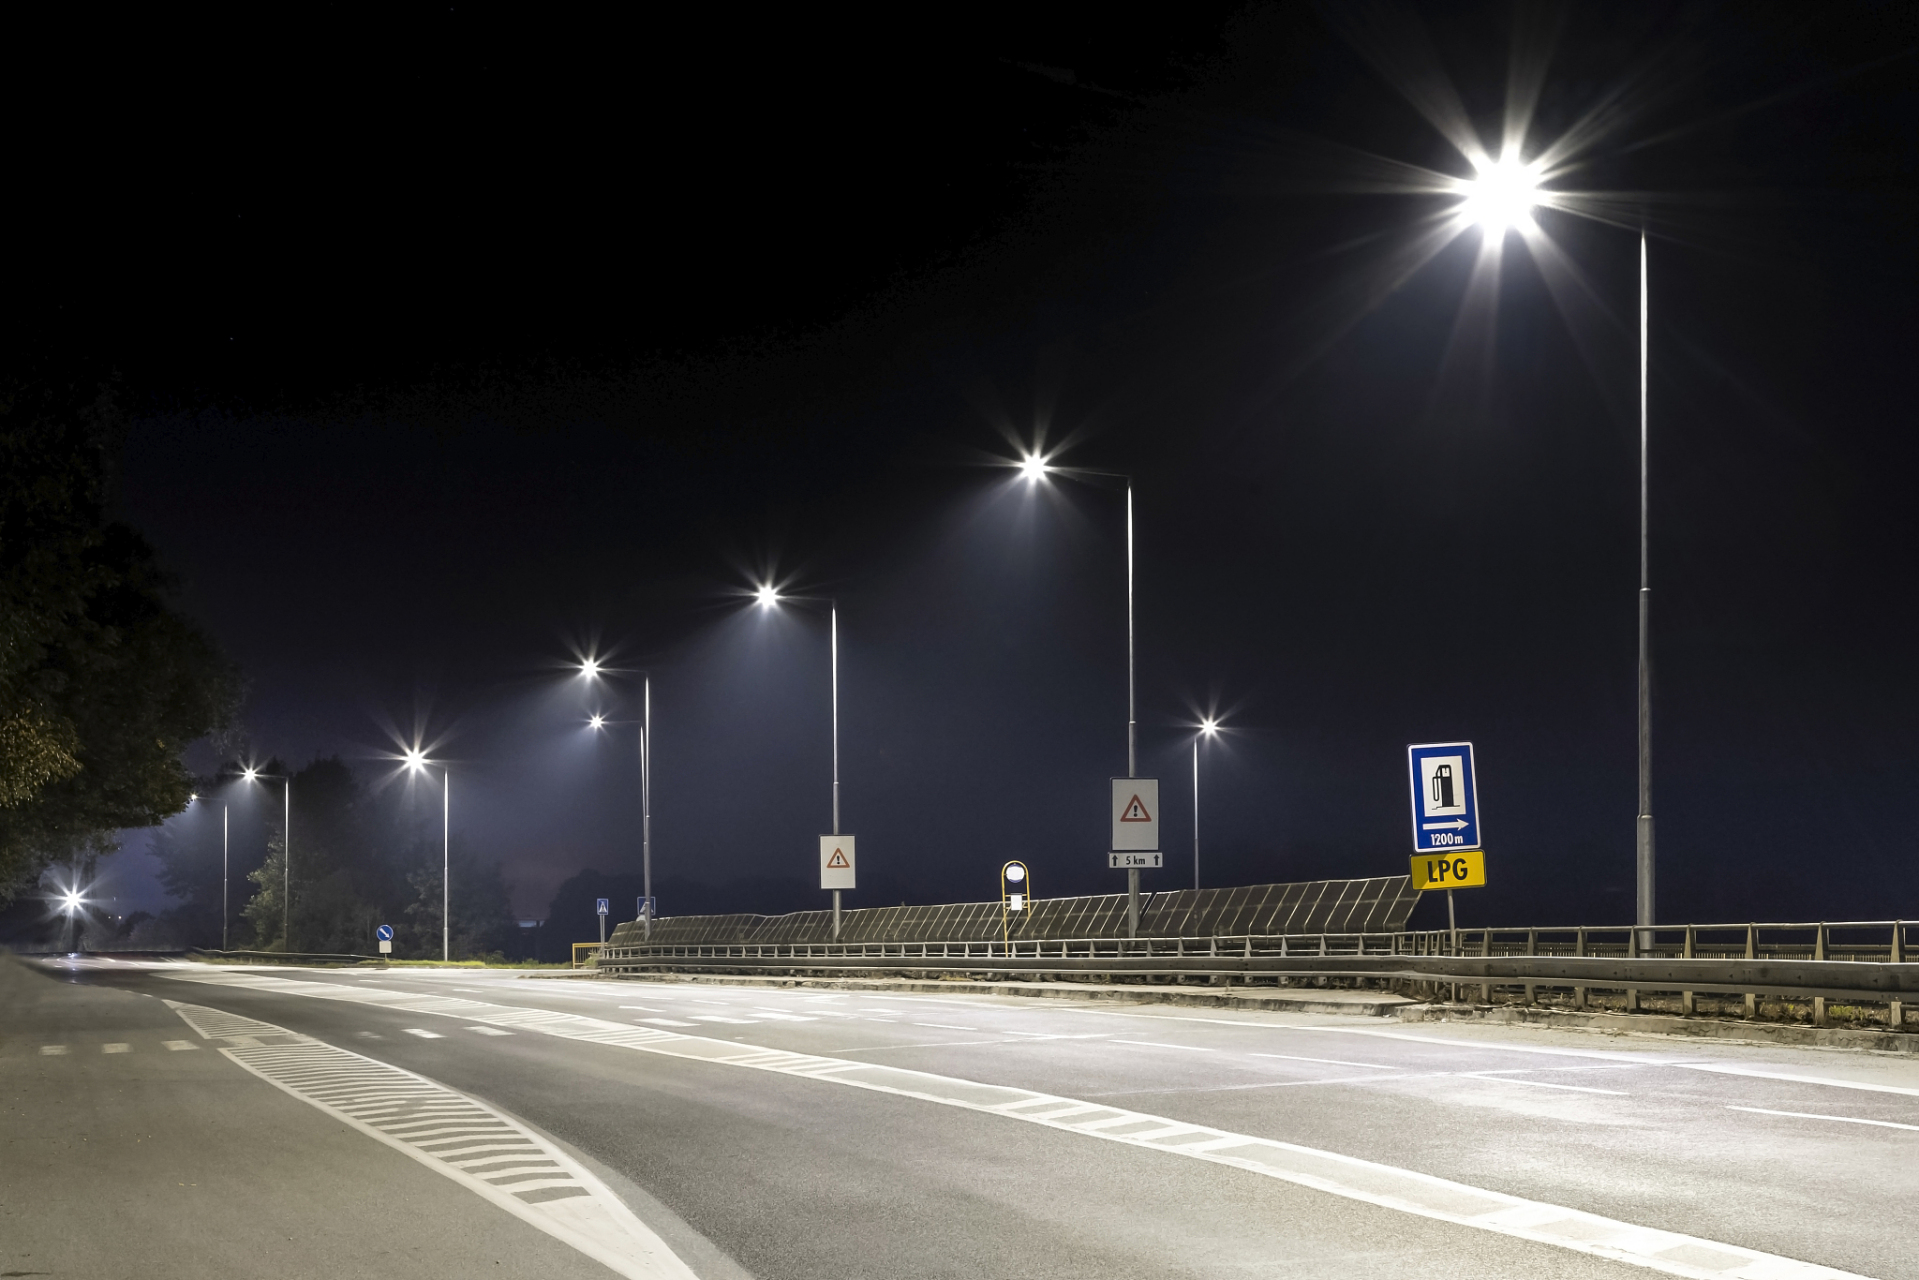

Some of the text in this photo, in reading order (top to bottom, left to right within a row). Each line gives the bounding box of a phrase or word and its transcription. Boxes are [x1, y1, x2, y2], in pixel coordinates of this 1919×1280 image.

[1126, 855, 1146, 865] 5 km
[1427, 858, 1468, 883] LPG
